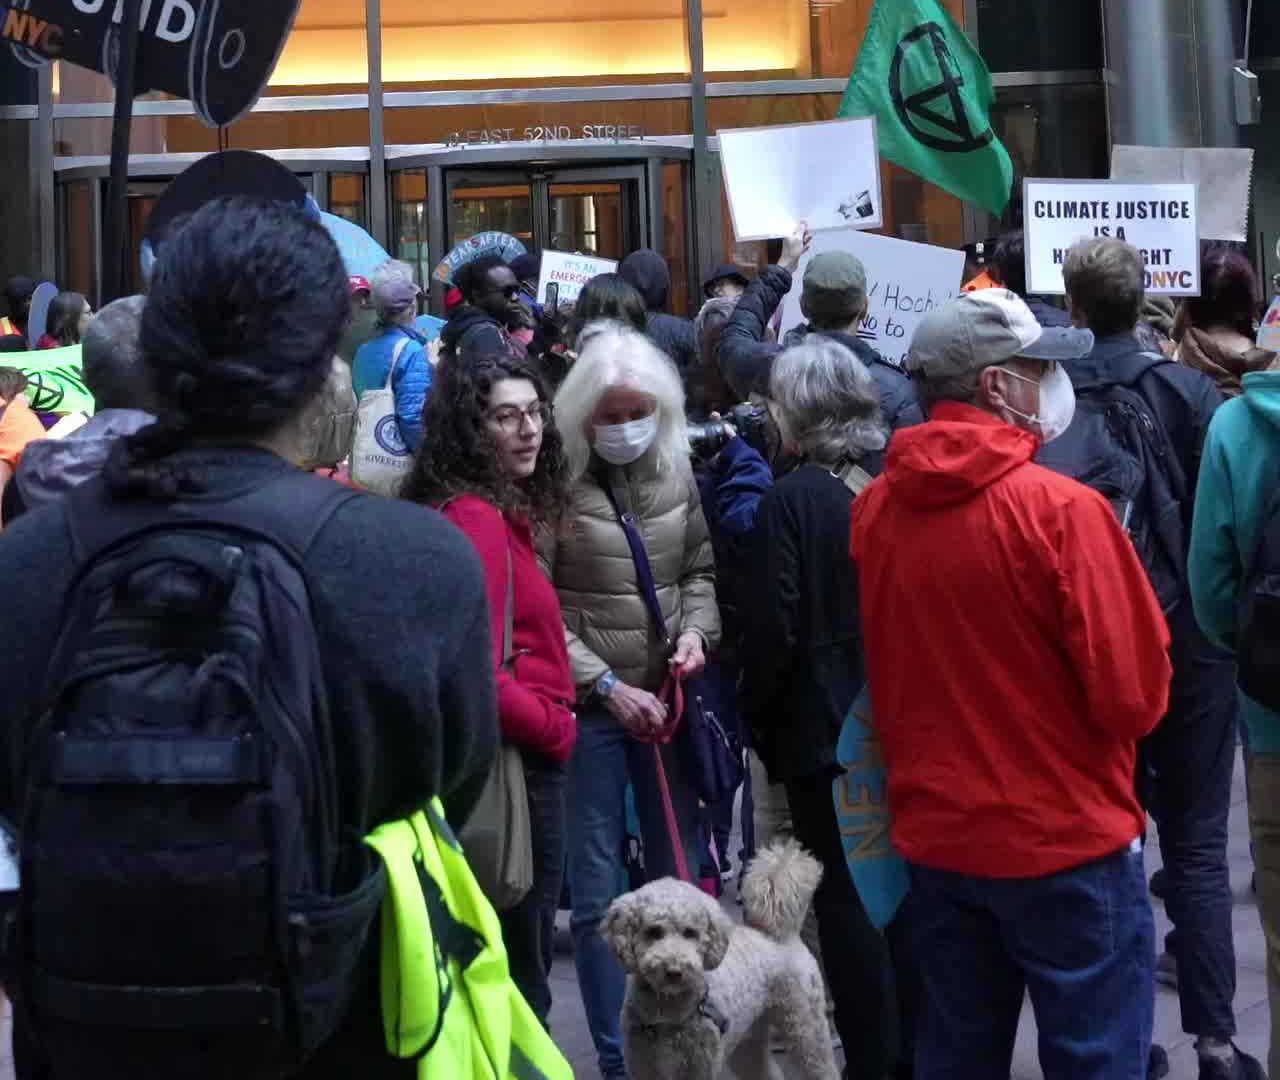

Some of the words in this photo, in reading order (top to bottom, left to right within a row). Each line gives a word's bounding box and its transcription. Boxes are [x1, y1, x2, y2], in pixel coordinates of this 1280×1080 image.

[465, 127, 514, 144] EAST
[523, 126, 571, 141] 52ND
[1034, 200, 1109, 219] CLIMATE
[1116, 200, 1190, 219] JUSTICE
[1093, 226, 1110, 239] IS
[1116, 226, 1127, 241] A
[885, 316, 905, 338] to
